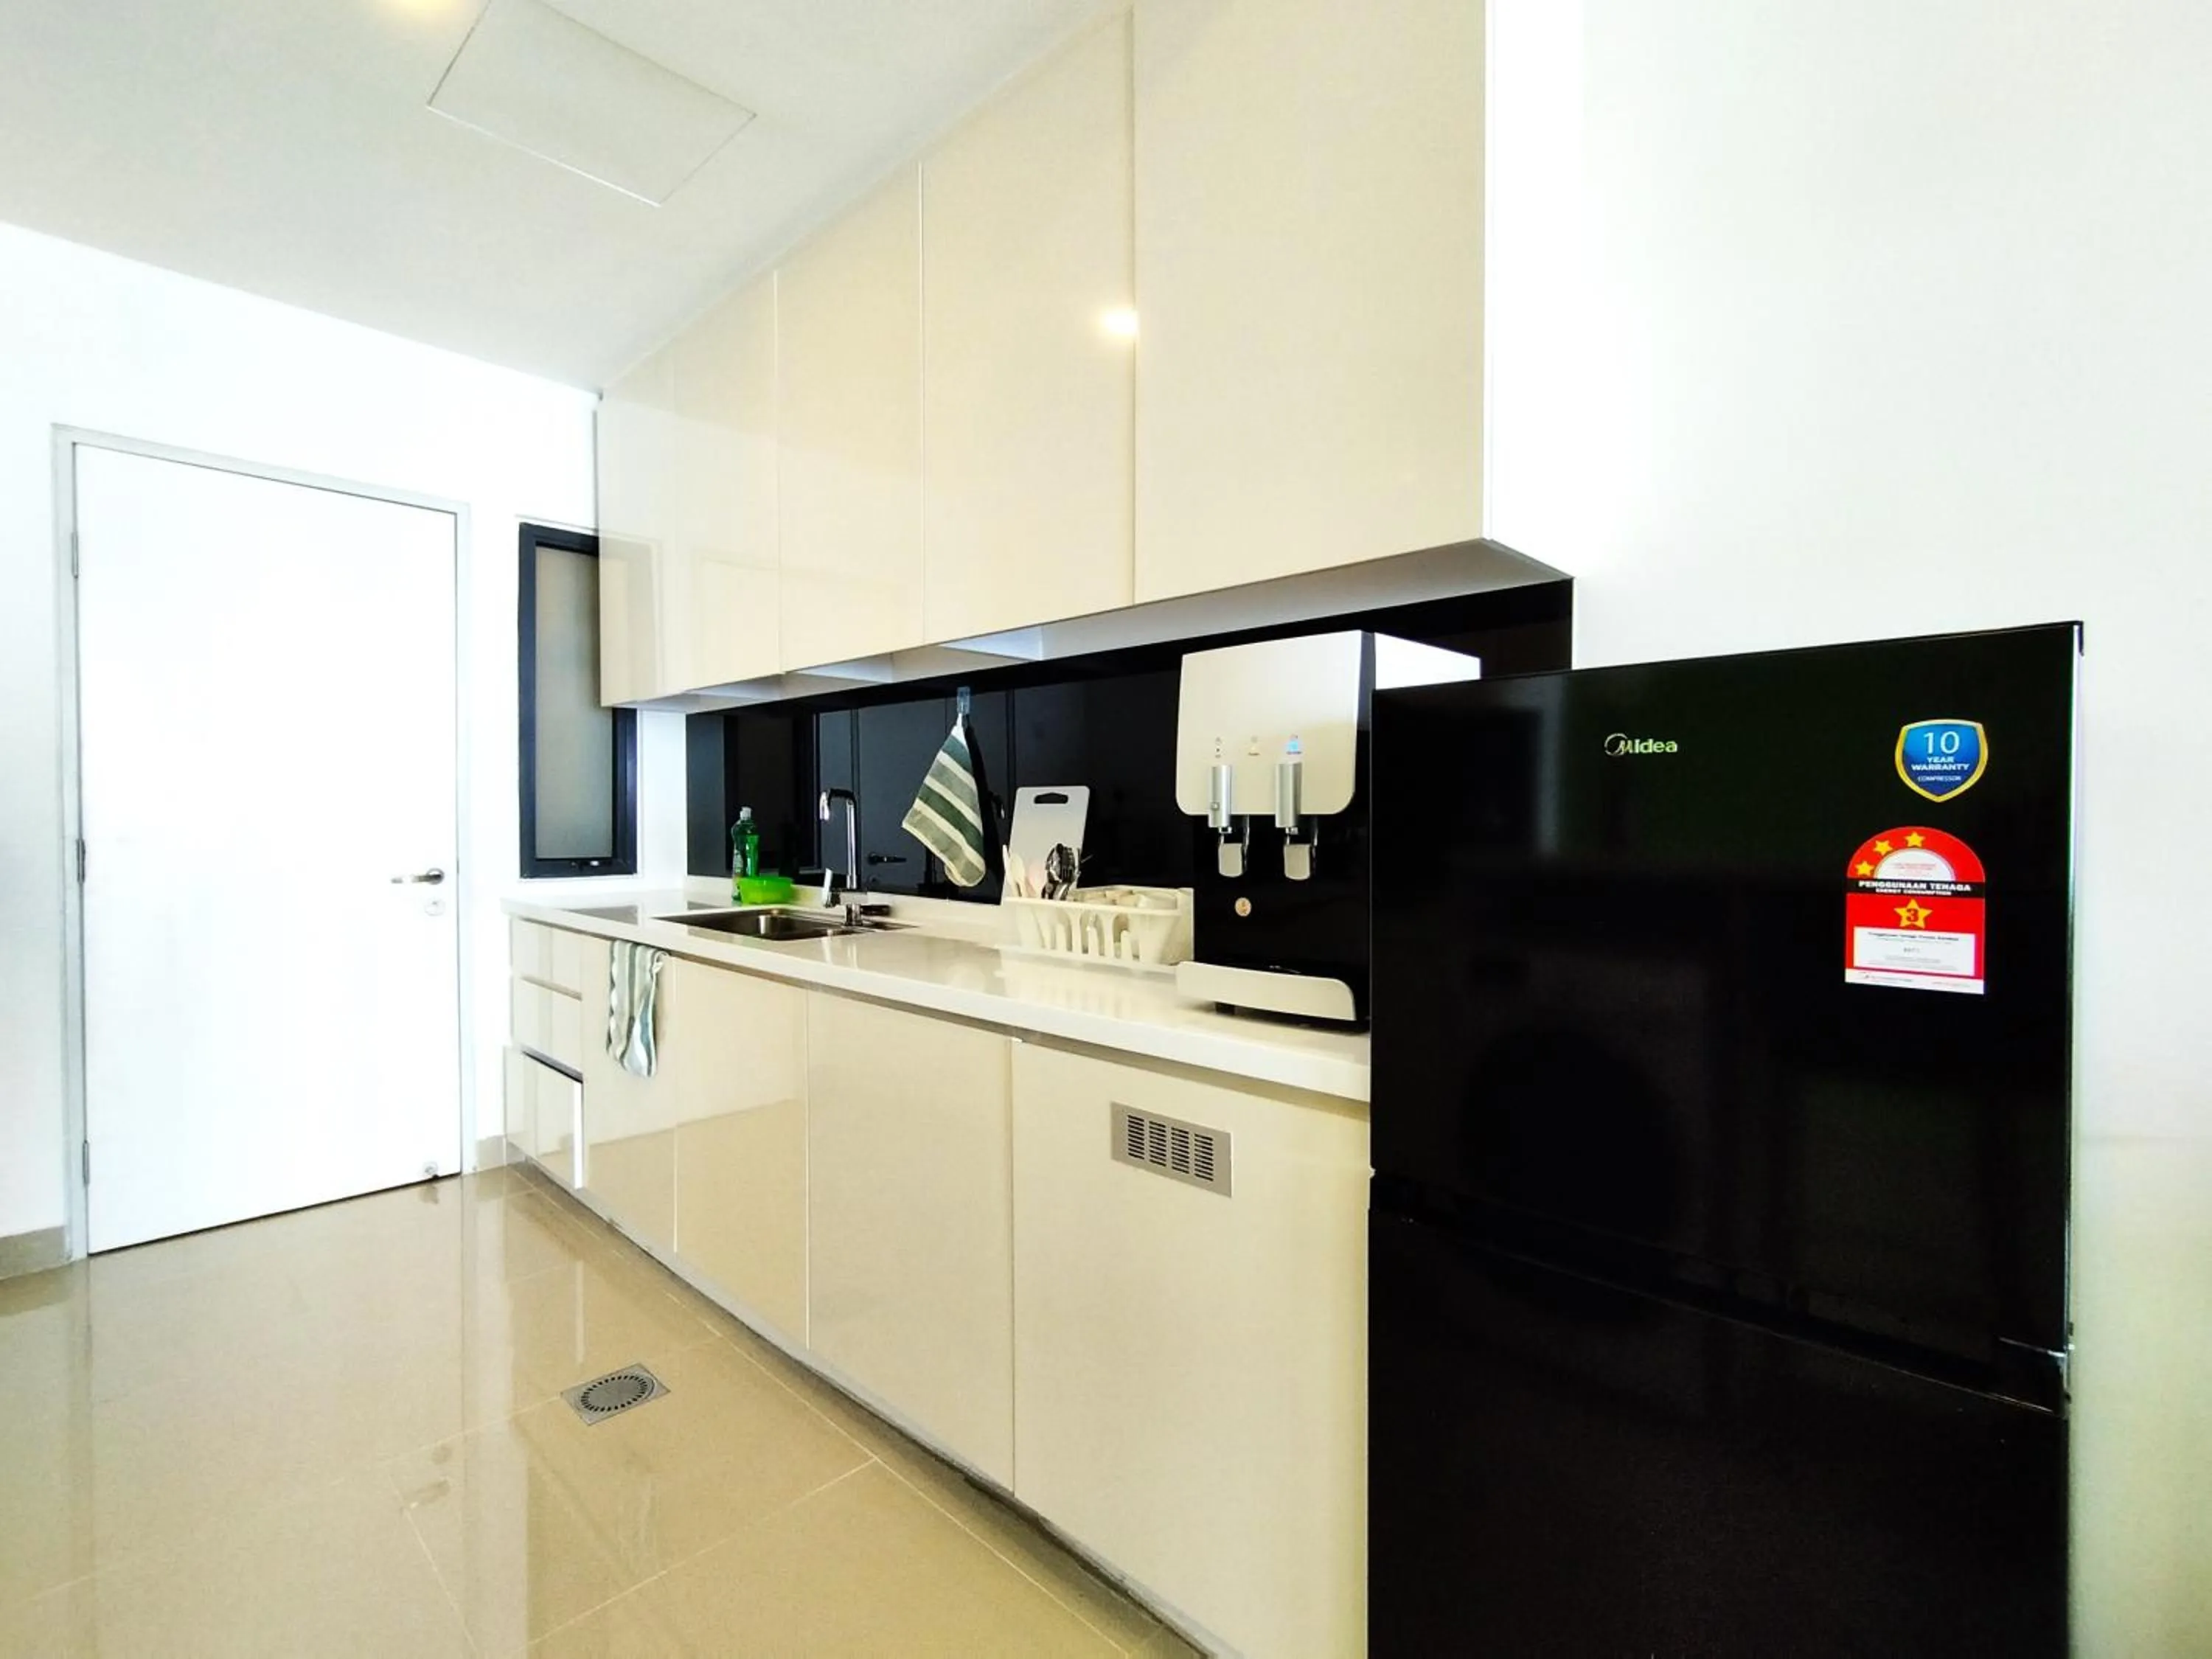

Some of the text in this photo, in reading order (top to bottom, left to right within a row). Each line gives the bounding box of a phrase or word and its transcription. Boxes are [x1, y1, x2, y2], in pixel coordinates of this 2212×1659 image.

[1604, 733, 1677, 757] Midea
[1924, 731, 1960, 754] 10
[1910, 763, 1970, 771] WARRANTY
[1859, 880, 1972, 891] PENGGUNAAN TENAGA
[1906, 908, 1919, 922] 3
